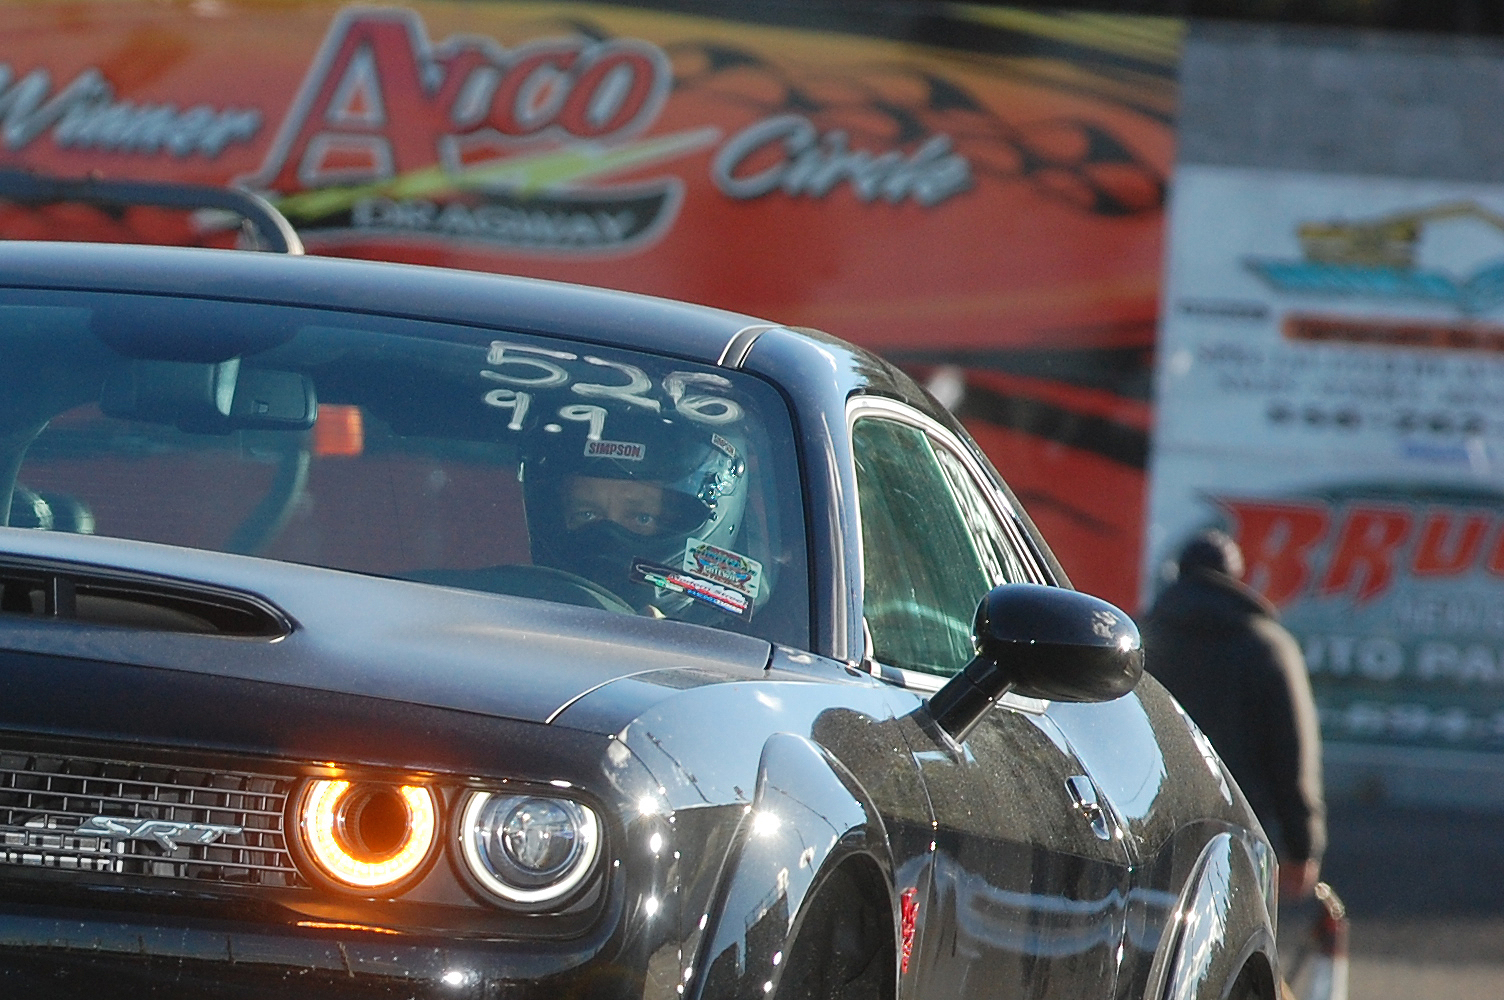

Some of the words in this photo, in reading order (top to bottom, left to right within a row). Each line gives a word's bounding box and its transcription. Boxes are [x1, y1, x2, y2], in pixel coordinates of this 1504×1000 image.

[712, 114, 973, 205] Circle
[479, 339, 745, 425] 526
[588, 442, 641, 458] SIMPSON
[76, 815, 244, 851] SRT
